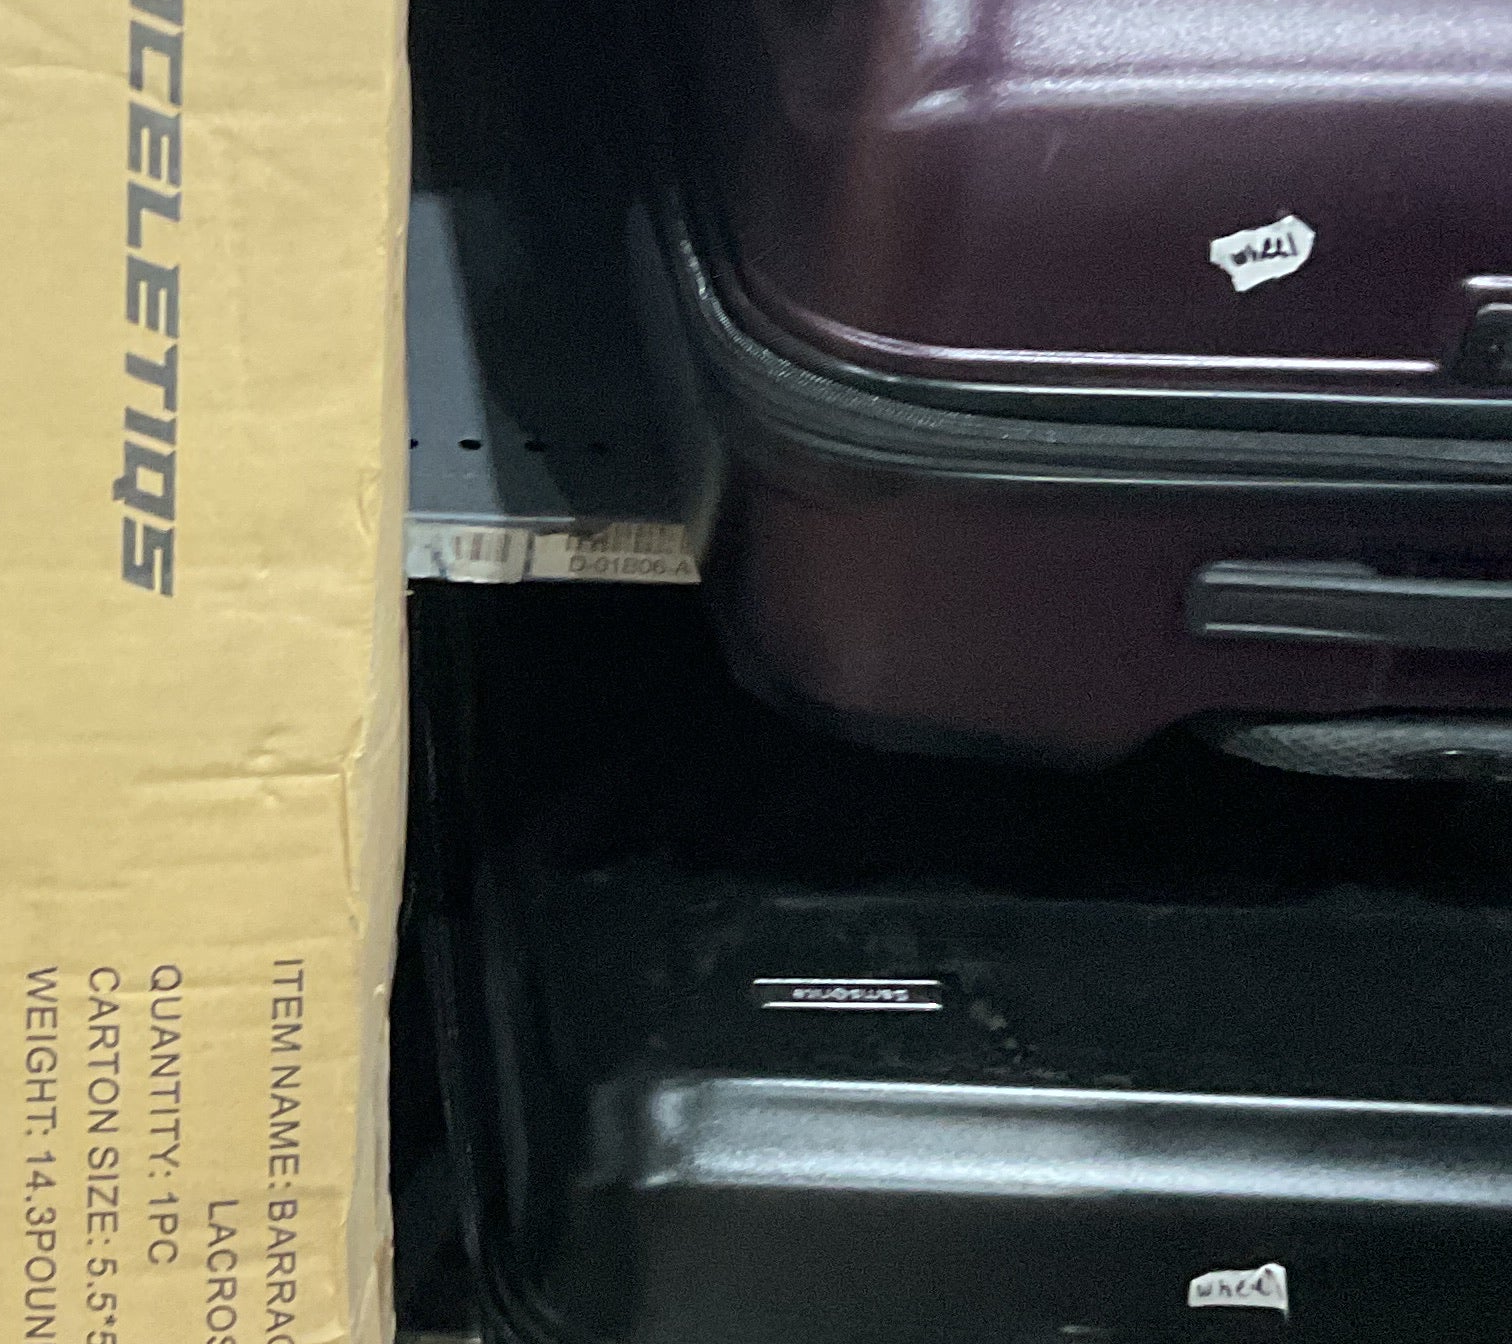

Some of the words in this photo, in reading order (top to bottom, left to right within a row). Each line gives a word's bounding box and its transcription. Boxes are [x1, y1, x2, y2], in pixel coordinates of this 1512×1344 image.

[25, 967, 59, 1137] WEIGHT:
[87, 966, 120, 1133] CARTON
[271, 959, 304, 1053] ITEM
[148, 964, 182, 1179] QUANTITY:
[267, 1066, 300, 1189] NAME:
[86, 1147, 118, 1245] SIZE:
[148, 1193, 179, 1266] 1PC
